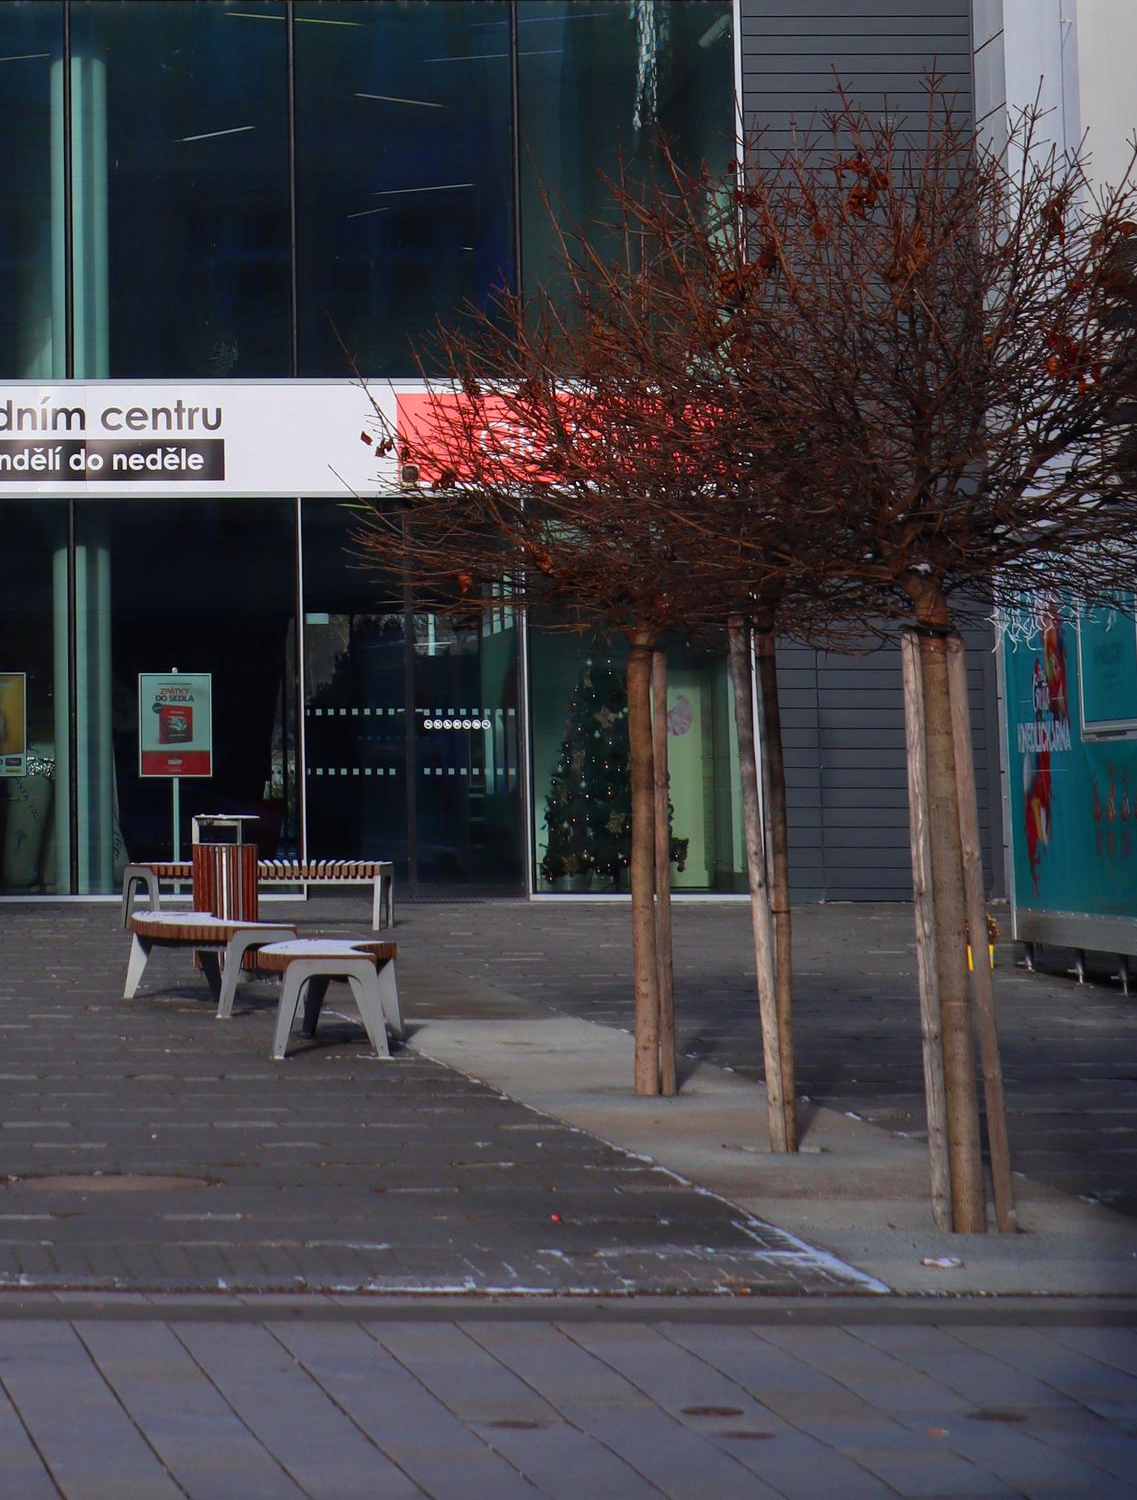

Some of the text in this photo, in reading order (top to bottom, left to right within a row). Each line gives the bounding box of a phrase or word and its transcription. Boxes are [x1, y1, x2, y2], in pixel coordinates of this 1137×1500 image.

[100, 399, 223, 432] centru
[69, 448, 104, 471] do
[112, 447, 205, 471] neděle
